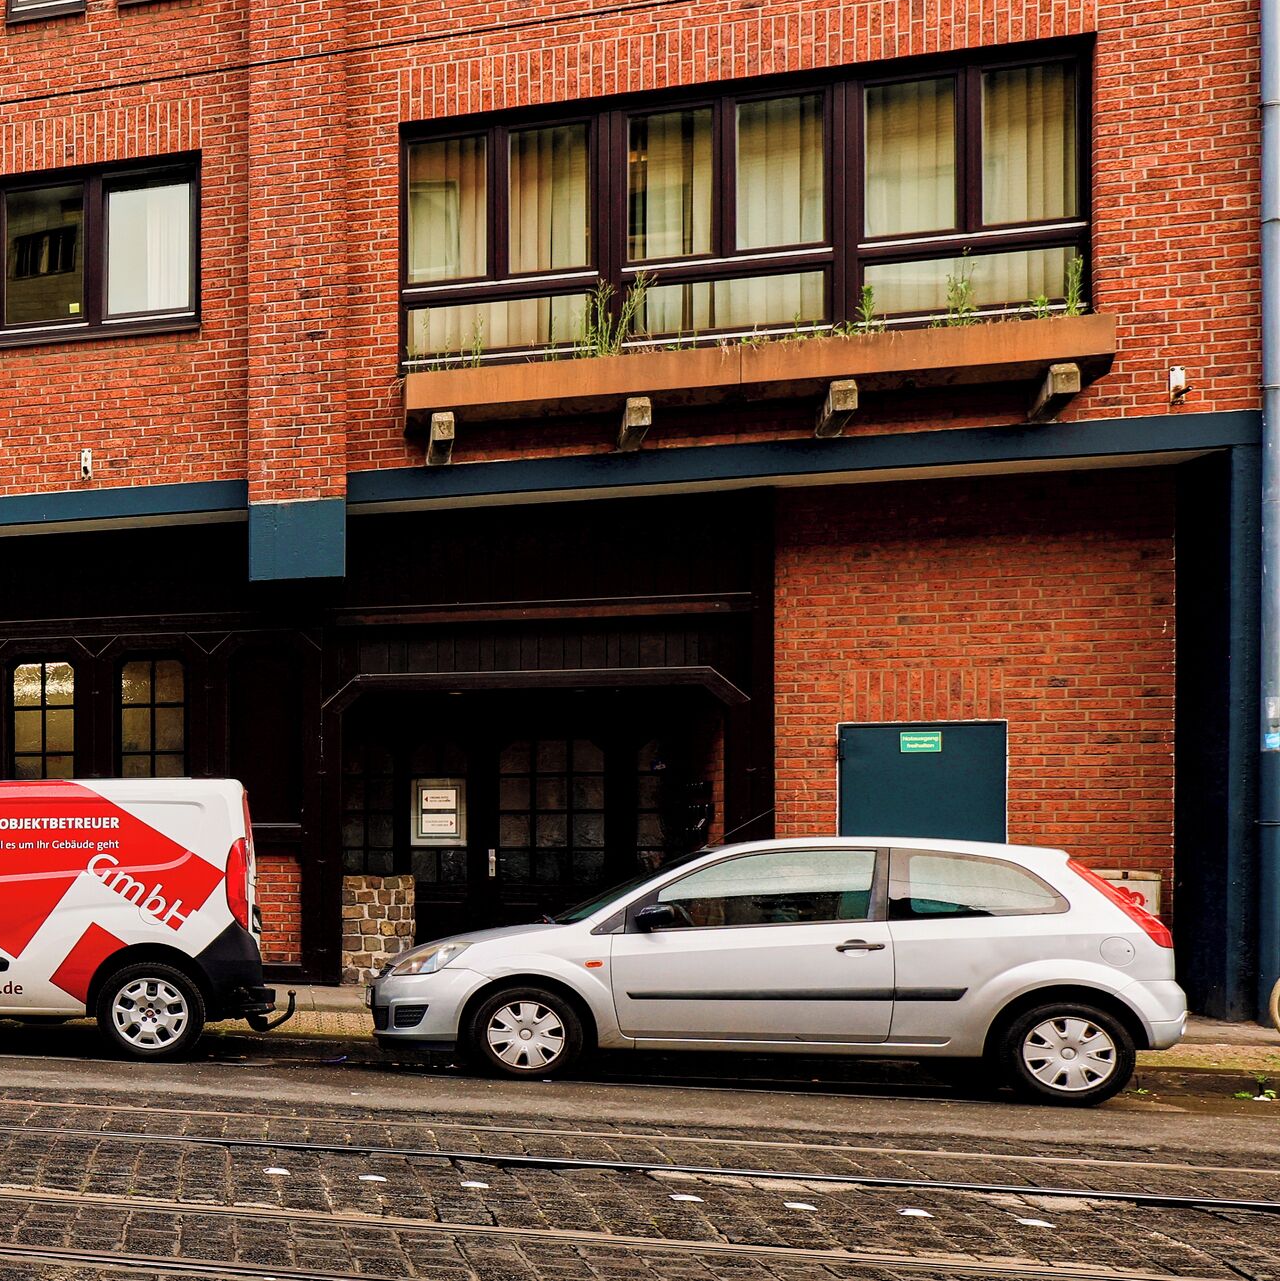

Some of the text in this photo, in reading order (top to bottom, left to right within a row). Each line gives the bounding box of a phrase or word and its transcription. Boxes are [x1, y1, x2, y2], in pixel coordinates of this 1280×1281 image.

[37, 840, 49, 849] Ihr
[52, 840, 94, 849] Gebäude
[96, 840, 120, 851] geht
[87, 853, 198, 931] GmbH
